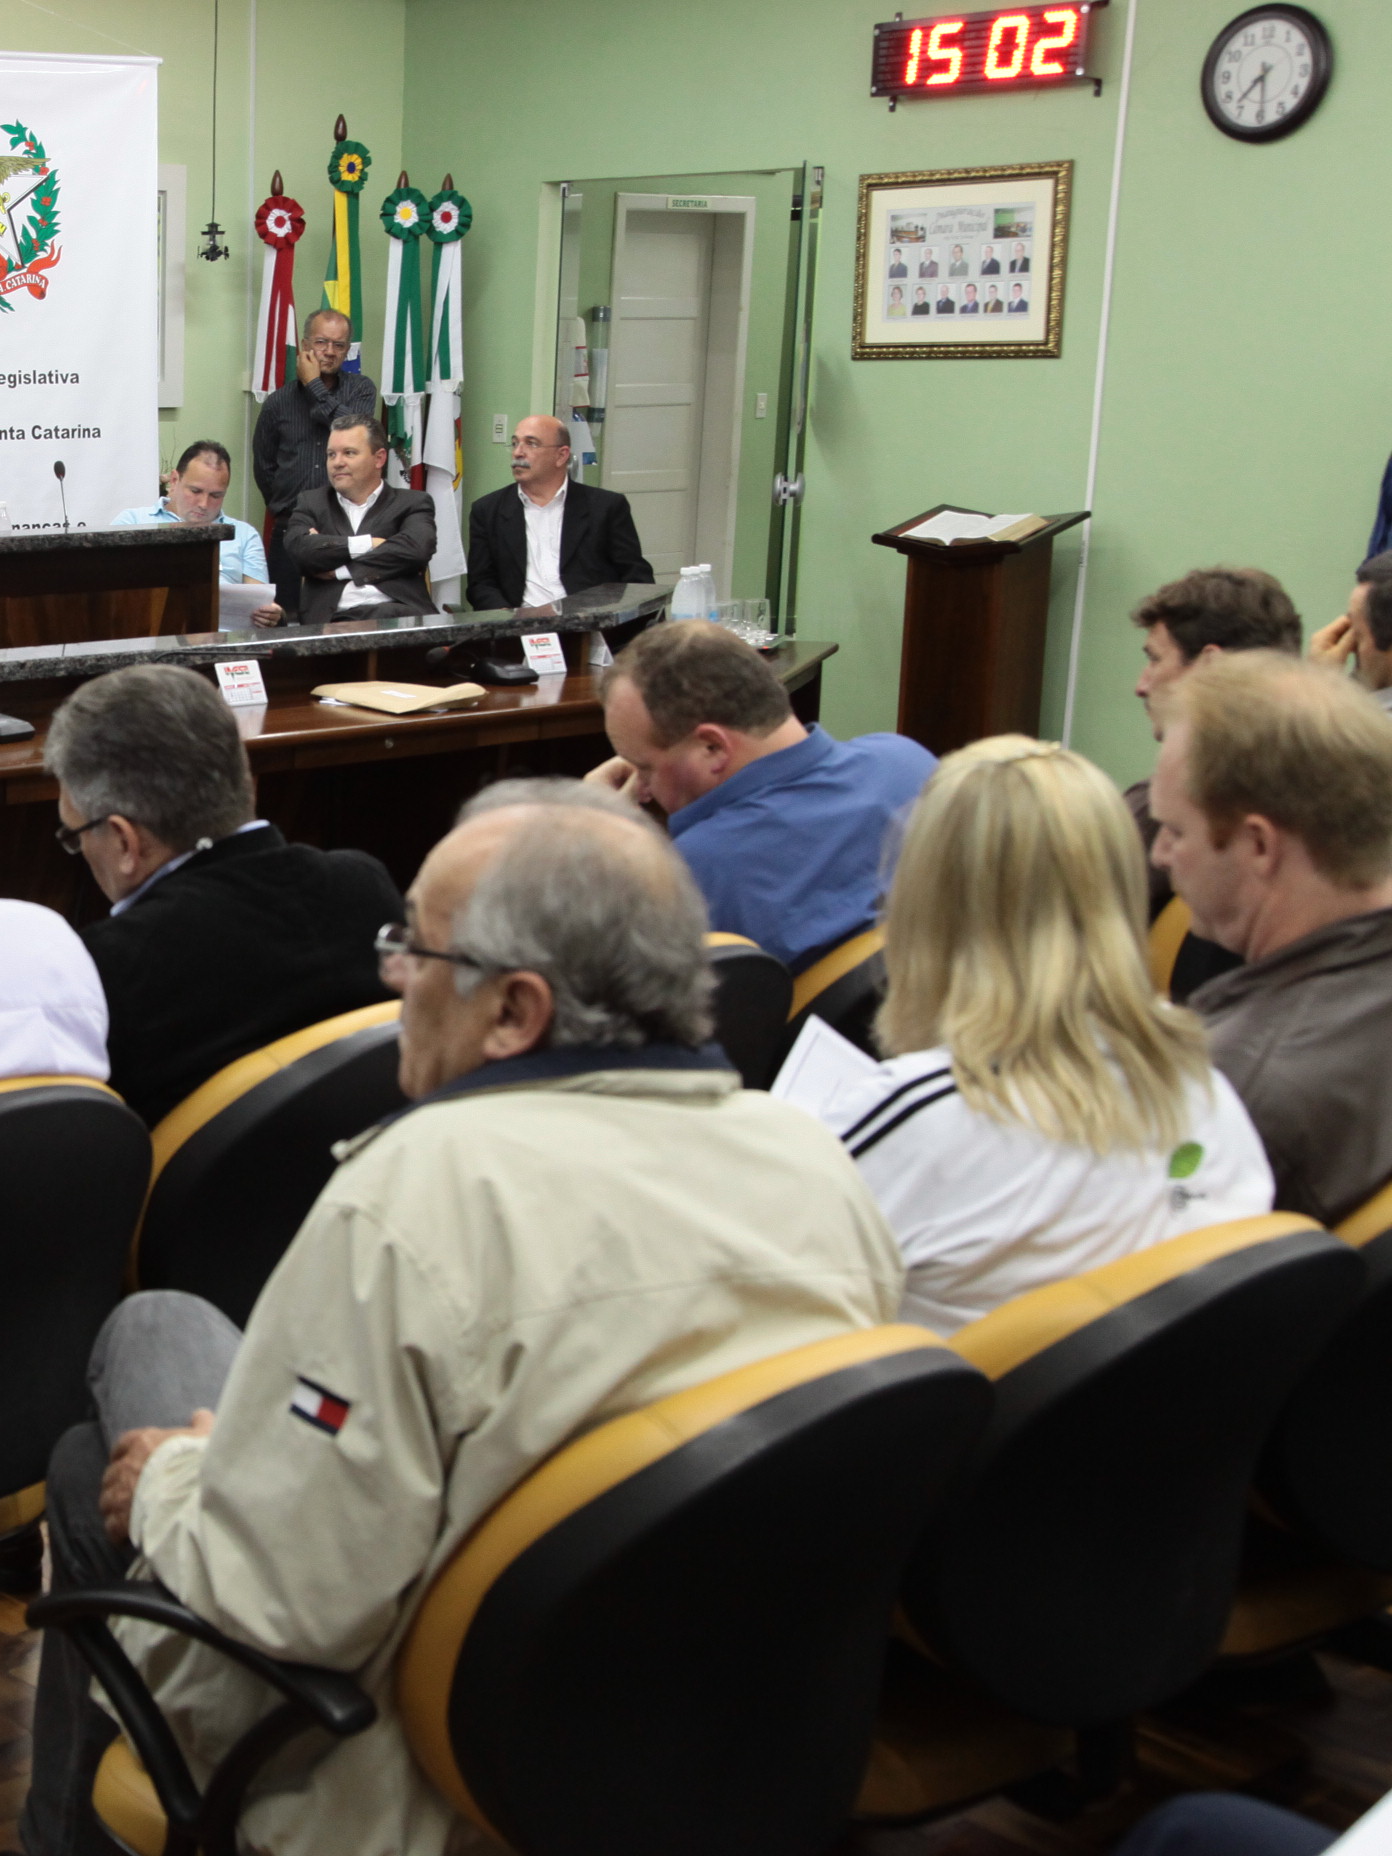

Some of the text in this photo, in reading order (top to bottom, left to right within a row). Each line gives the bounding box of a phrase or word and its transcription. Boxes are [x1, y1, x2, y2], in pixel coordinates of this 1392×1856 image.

[905, 8, 1078, 85] 15 02
[5, 273, 47, 289] CATARINA
[31, 424, 102, 440] Catarina
